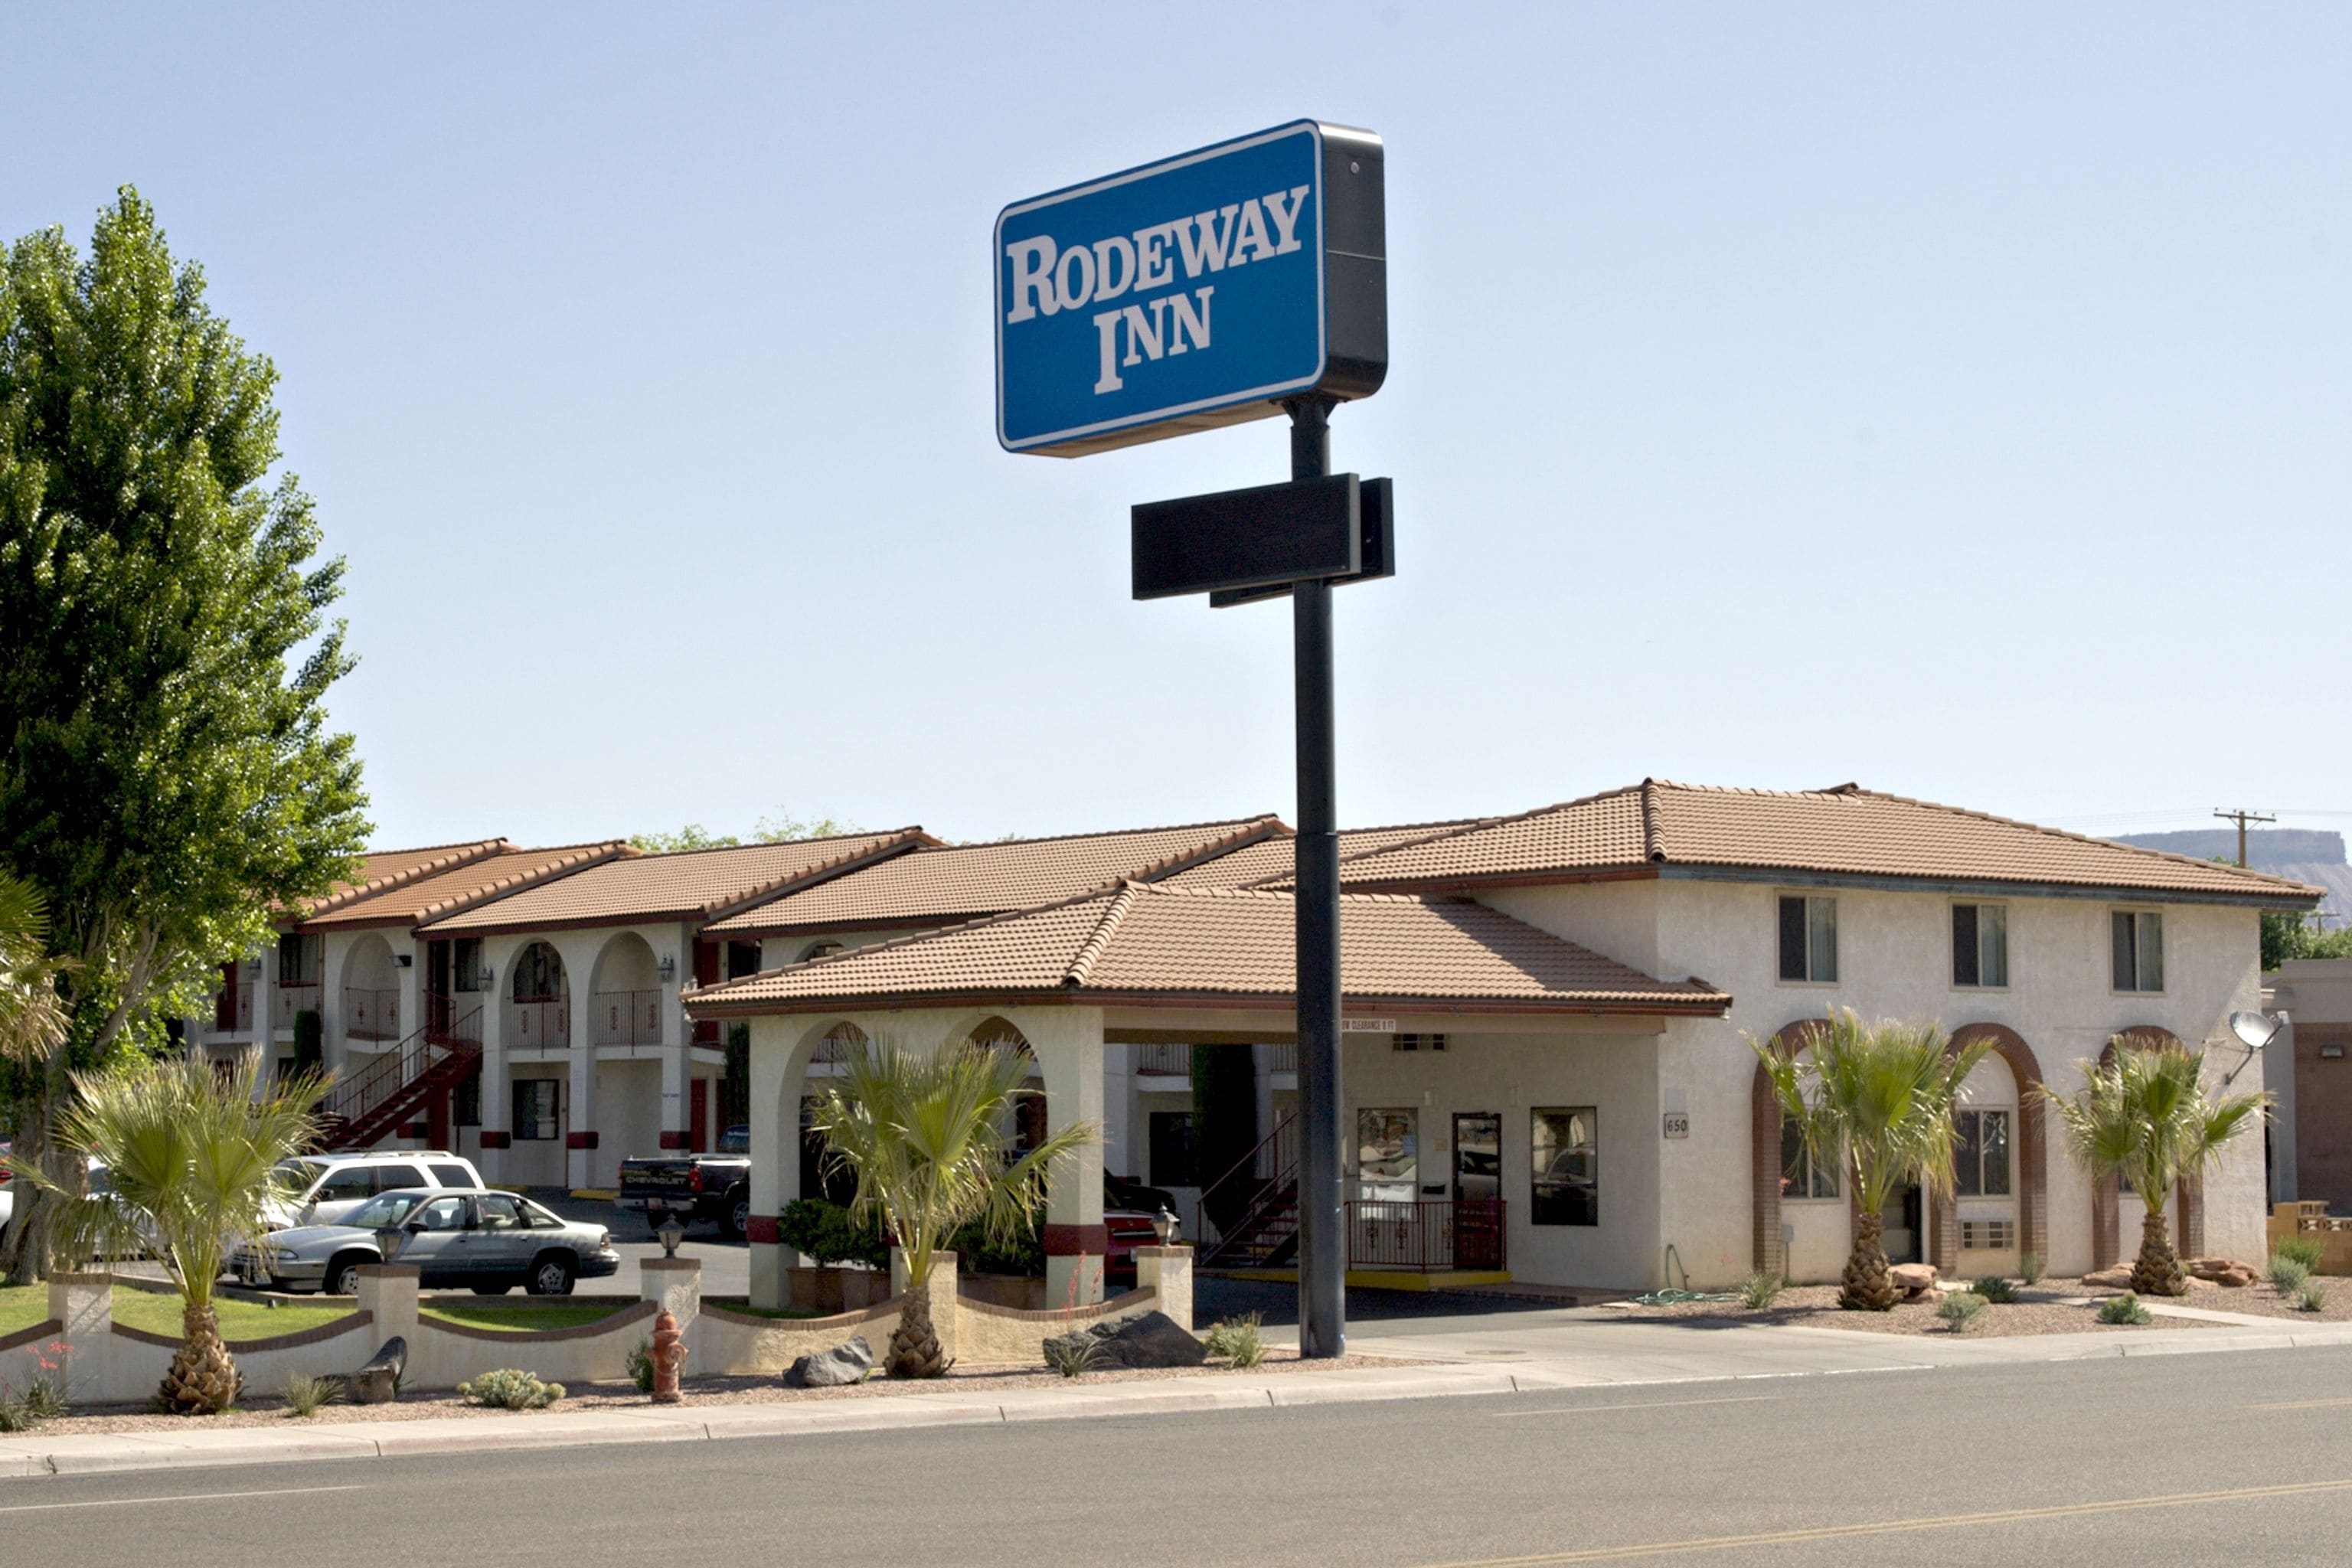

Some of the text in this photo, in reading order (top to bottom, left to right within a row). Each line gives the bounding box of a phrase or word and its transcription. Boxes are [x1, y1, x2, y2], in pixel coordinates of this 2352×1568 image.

[1006, 185, 1309, 325] RODEWAY
[1093, 286, 1214, 395] INN
[1341, 1021, 1350, 1031] OW
[1352, 1021, 1380, 1031] CLEARANCE
[1668, 1119, 1687, 1132] 650
[626, 1176, 686, 1185] CHEVROLET
